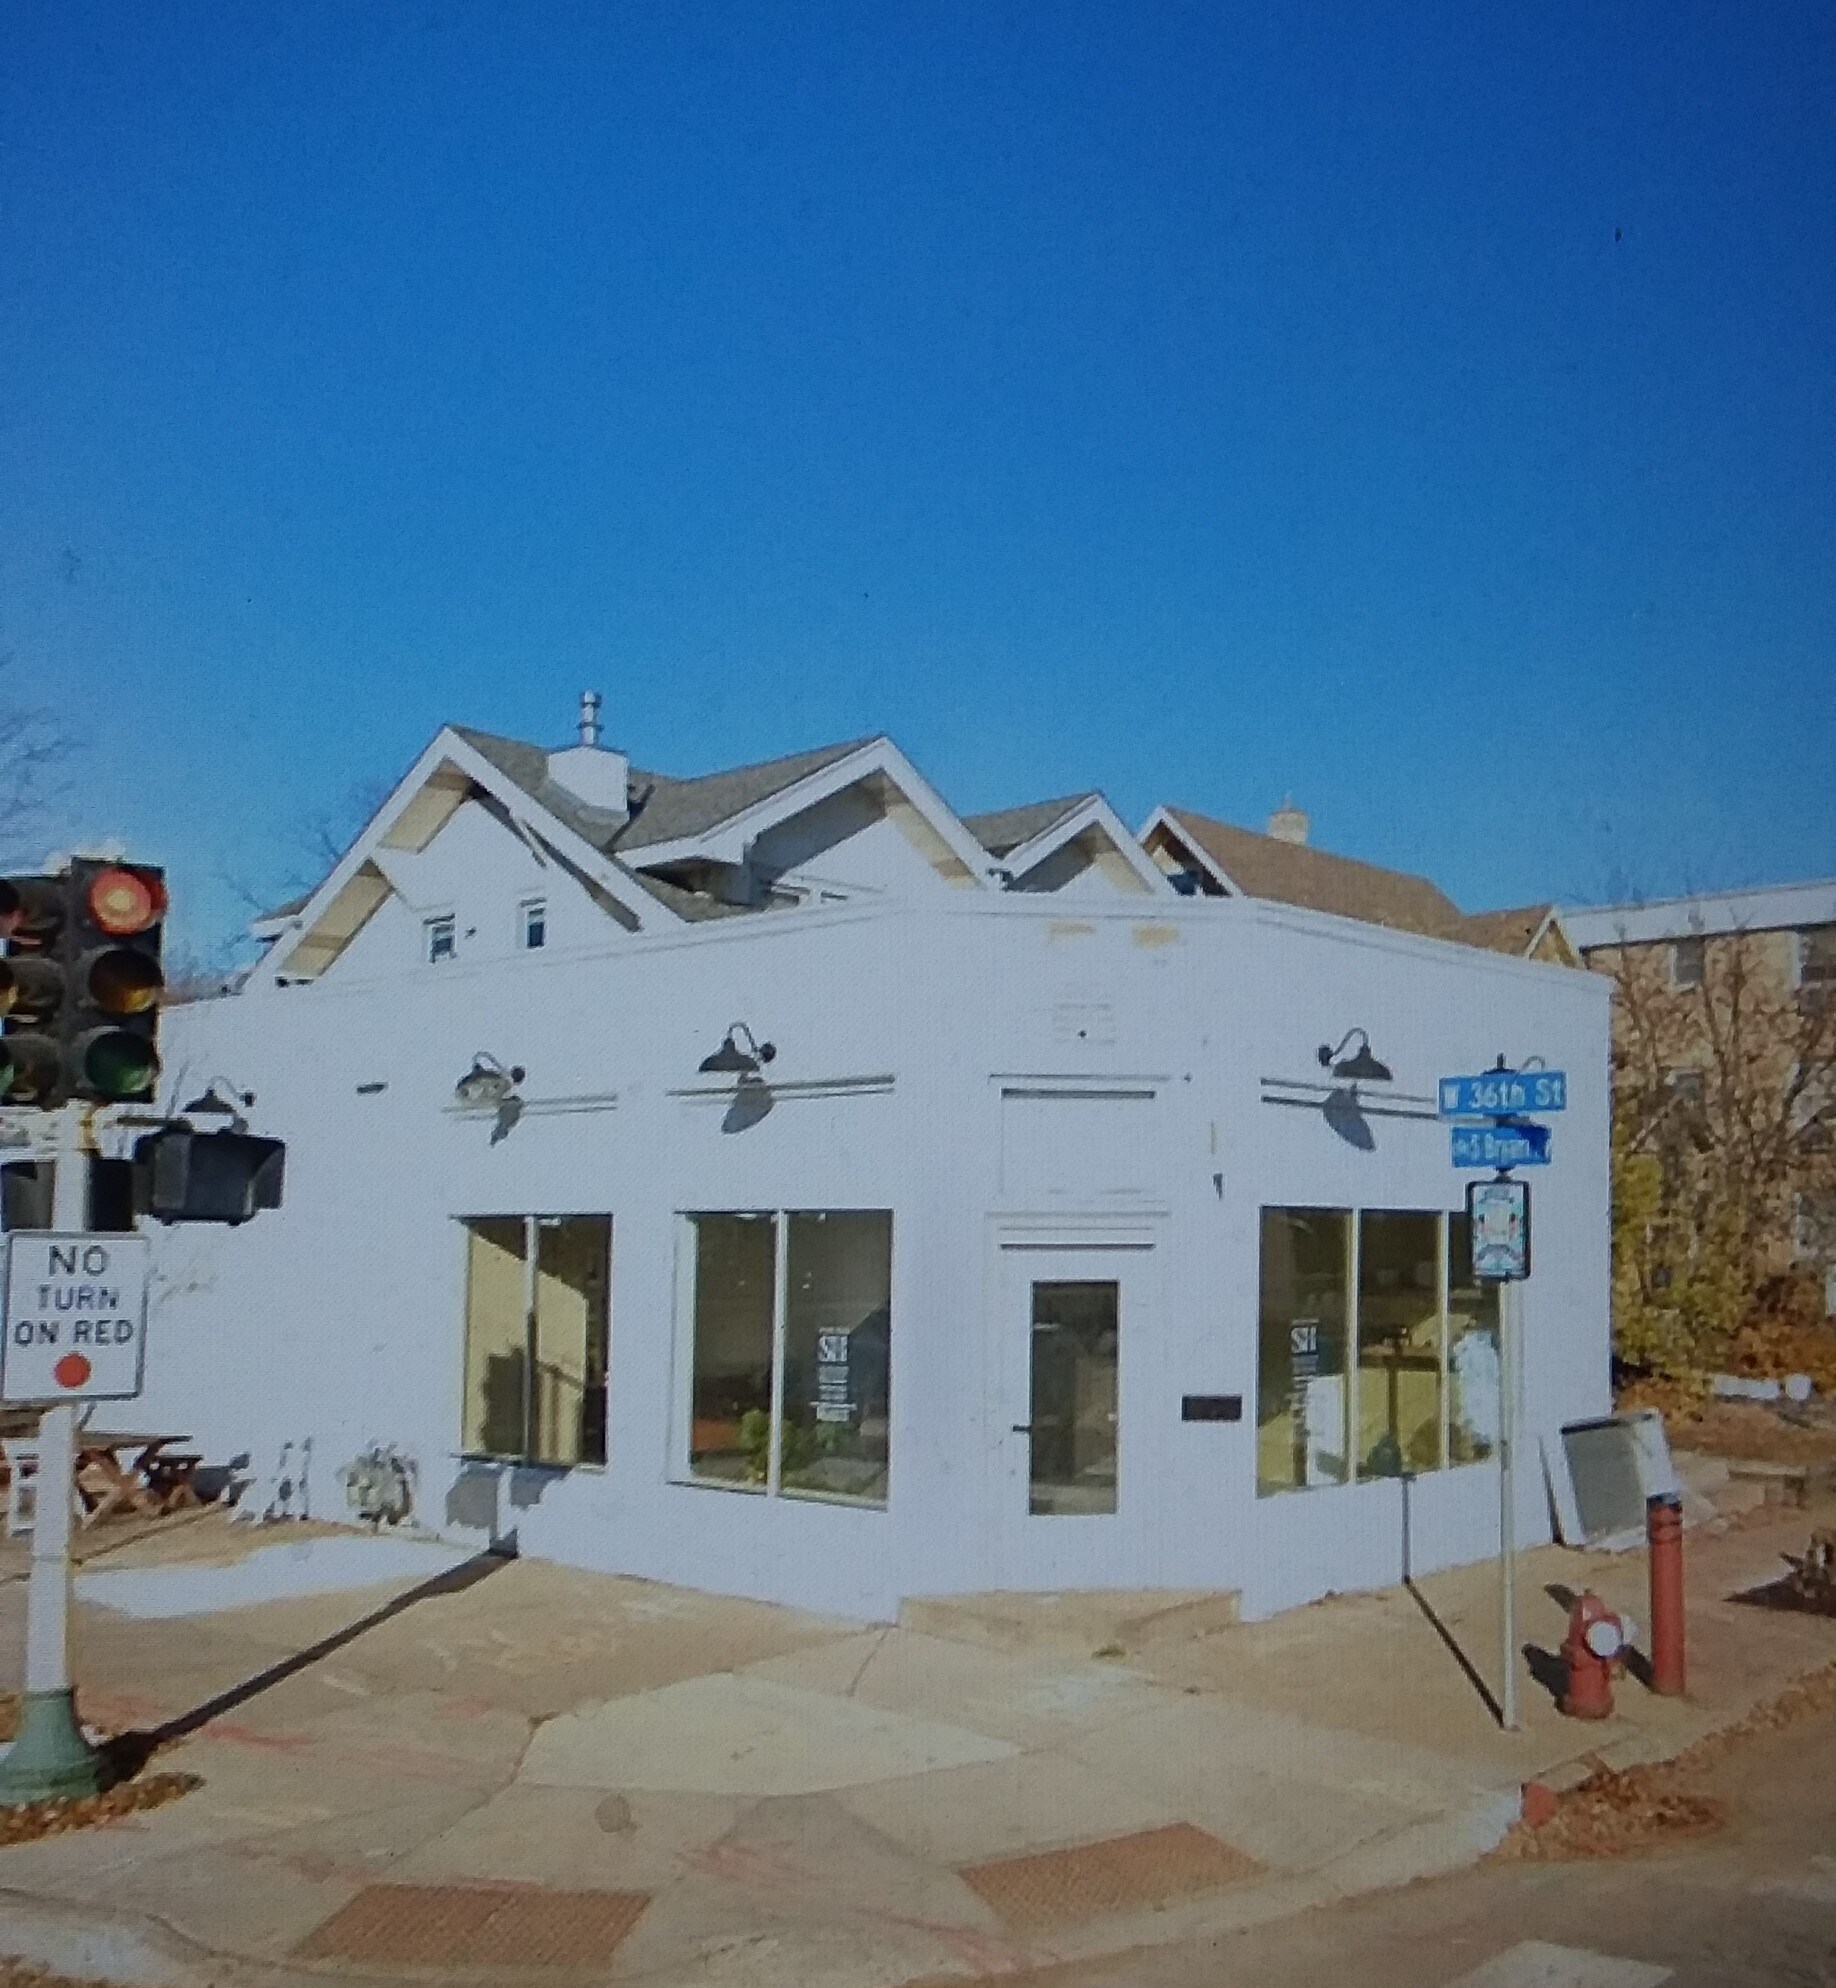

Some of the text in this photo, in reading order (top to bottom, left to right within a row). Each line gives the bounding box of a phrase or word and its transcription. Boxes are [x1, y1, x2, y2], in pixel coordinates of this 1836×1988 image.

[1470, 1081, 1525, 1109] 36th
[1535, 1078, 1562, 1106] St
[48, 1244, 108, 1276] NO
[38, 1284, 119, 1311] TURN
[14, 1319, 134, 1346] ON RED
